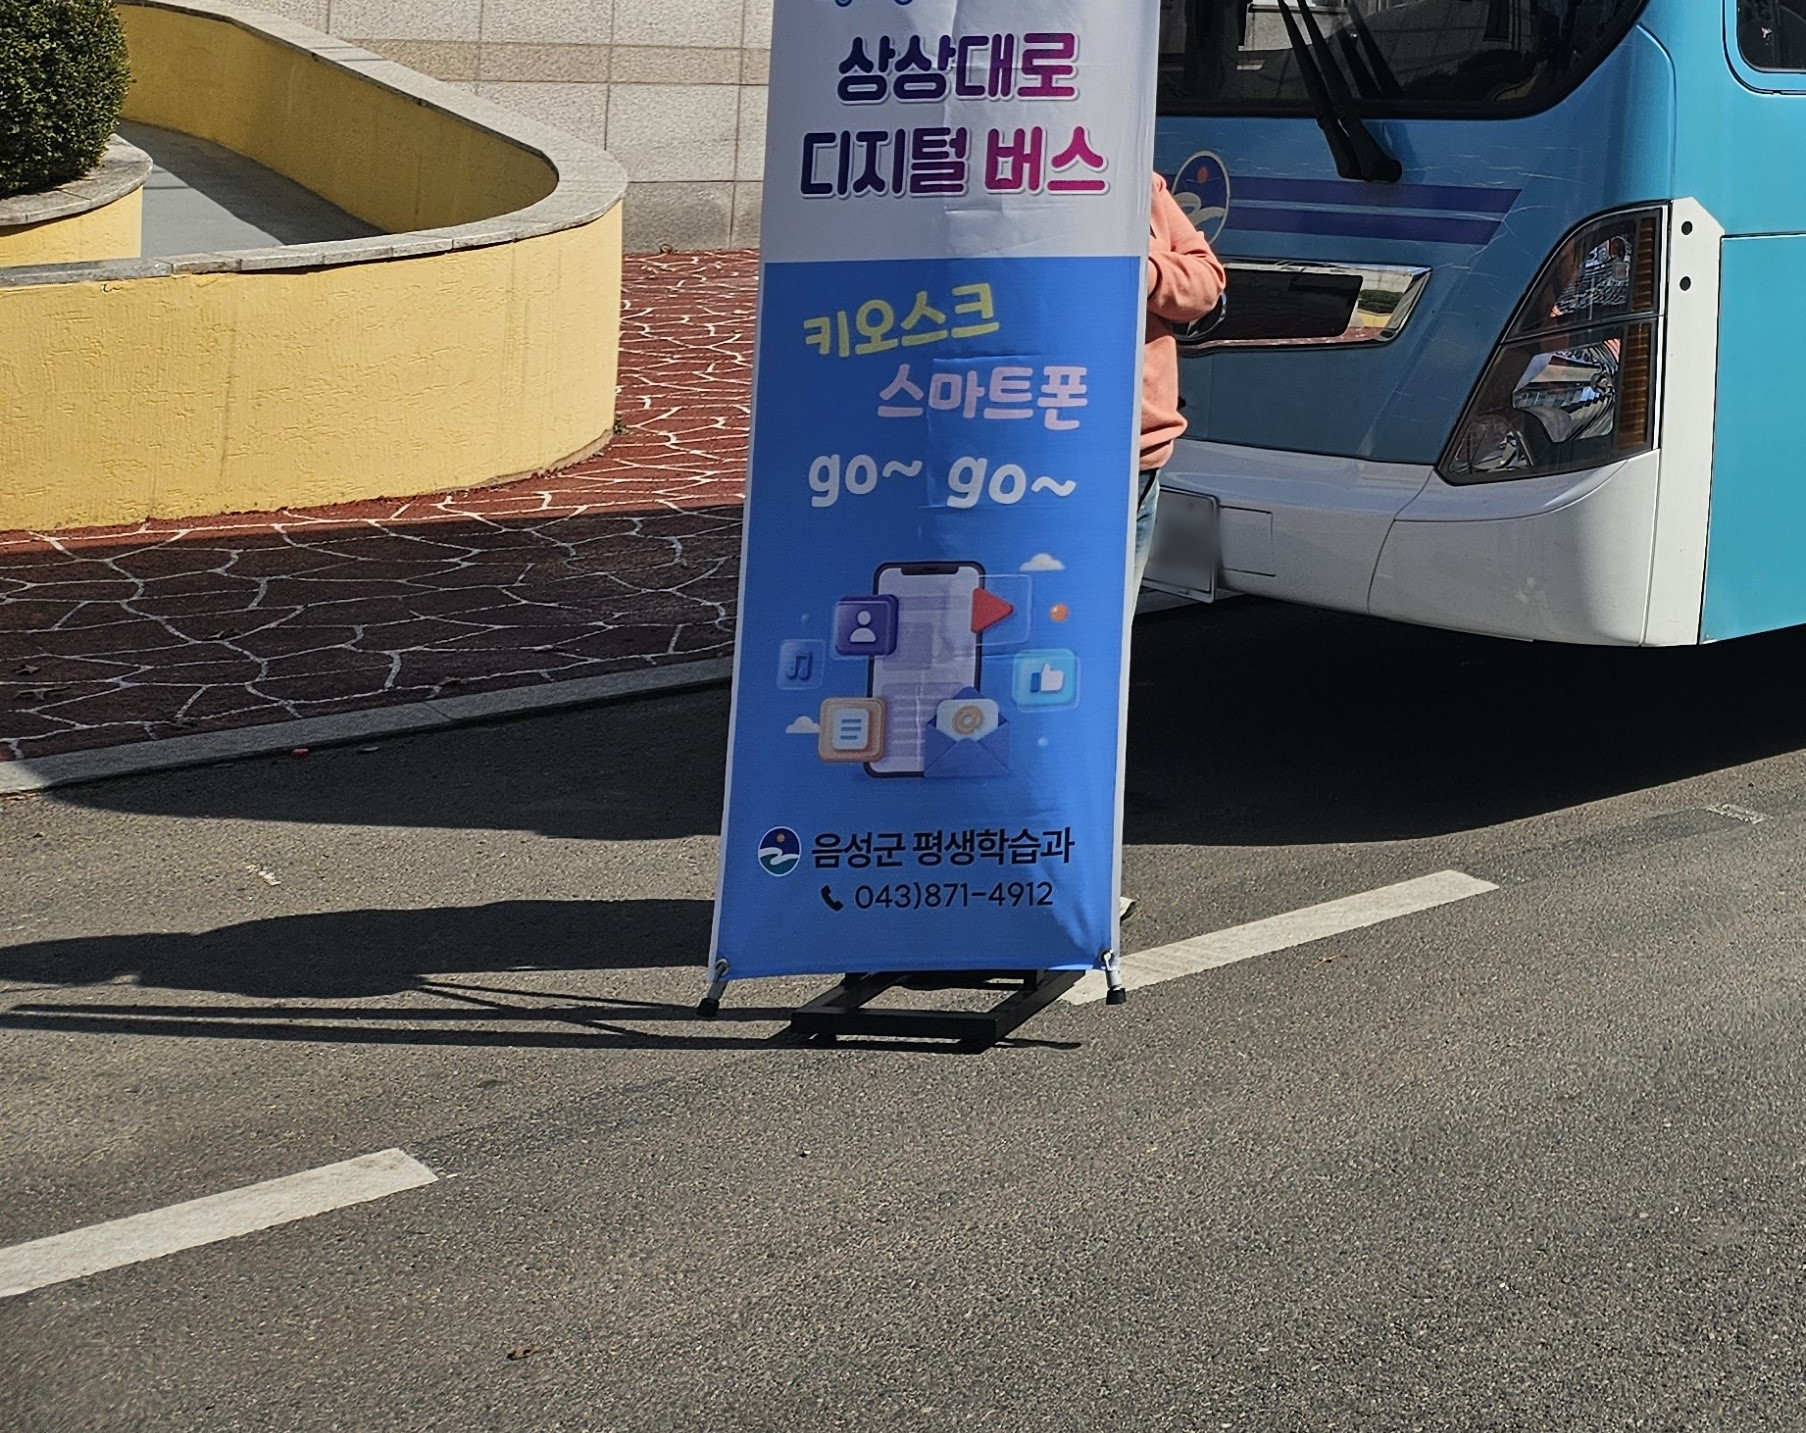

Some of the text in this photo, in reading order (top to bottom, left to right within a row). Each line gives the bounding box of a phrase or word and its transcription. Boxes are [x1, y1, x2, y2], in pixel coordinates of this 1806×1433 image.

[837, 32, 1079, 103] 상상대로
[801, 125, 1108, 197] 디지털 버스
[803, 283, 999, 358] 키오스크
[877, 364, 1088, 431] 스마트폰
[808, 454, 1076, 509] go~ go~
[811, 826, 1076, 869] 음성군 평생학습과
[854, 881, 1054, 911] 043)871-4912
